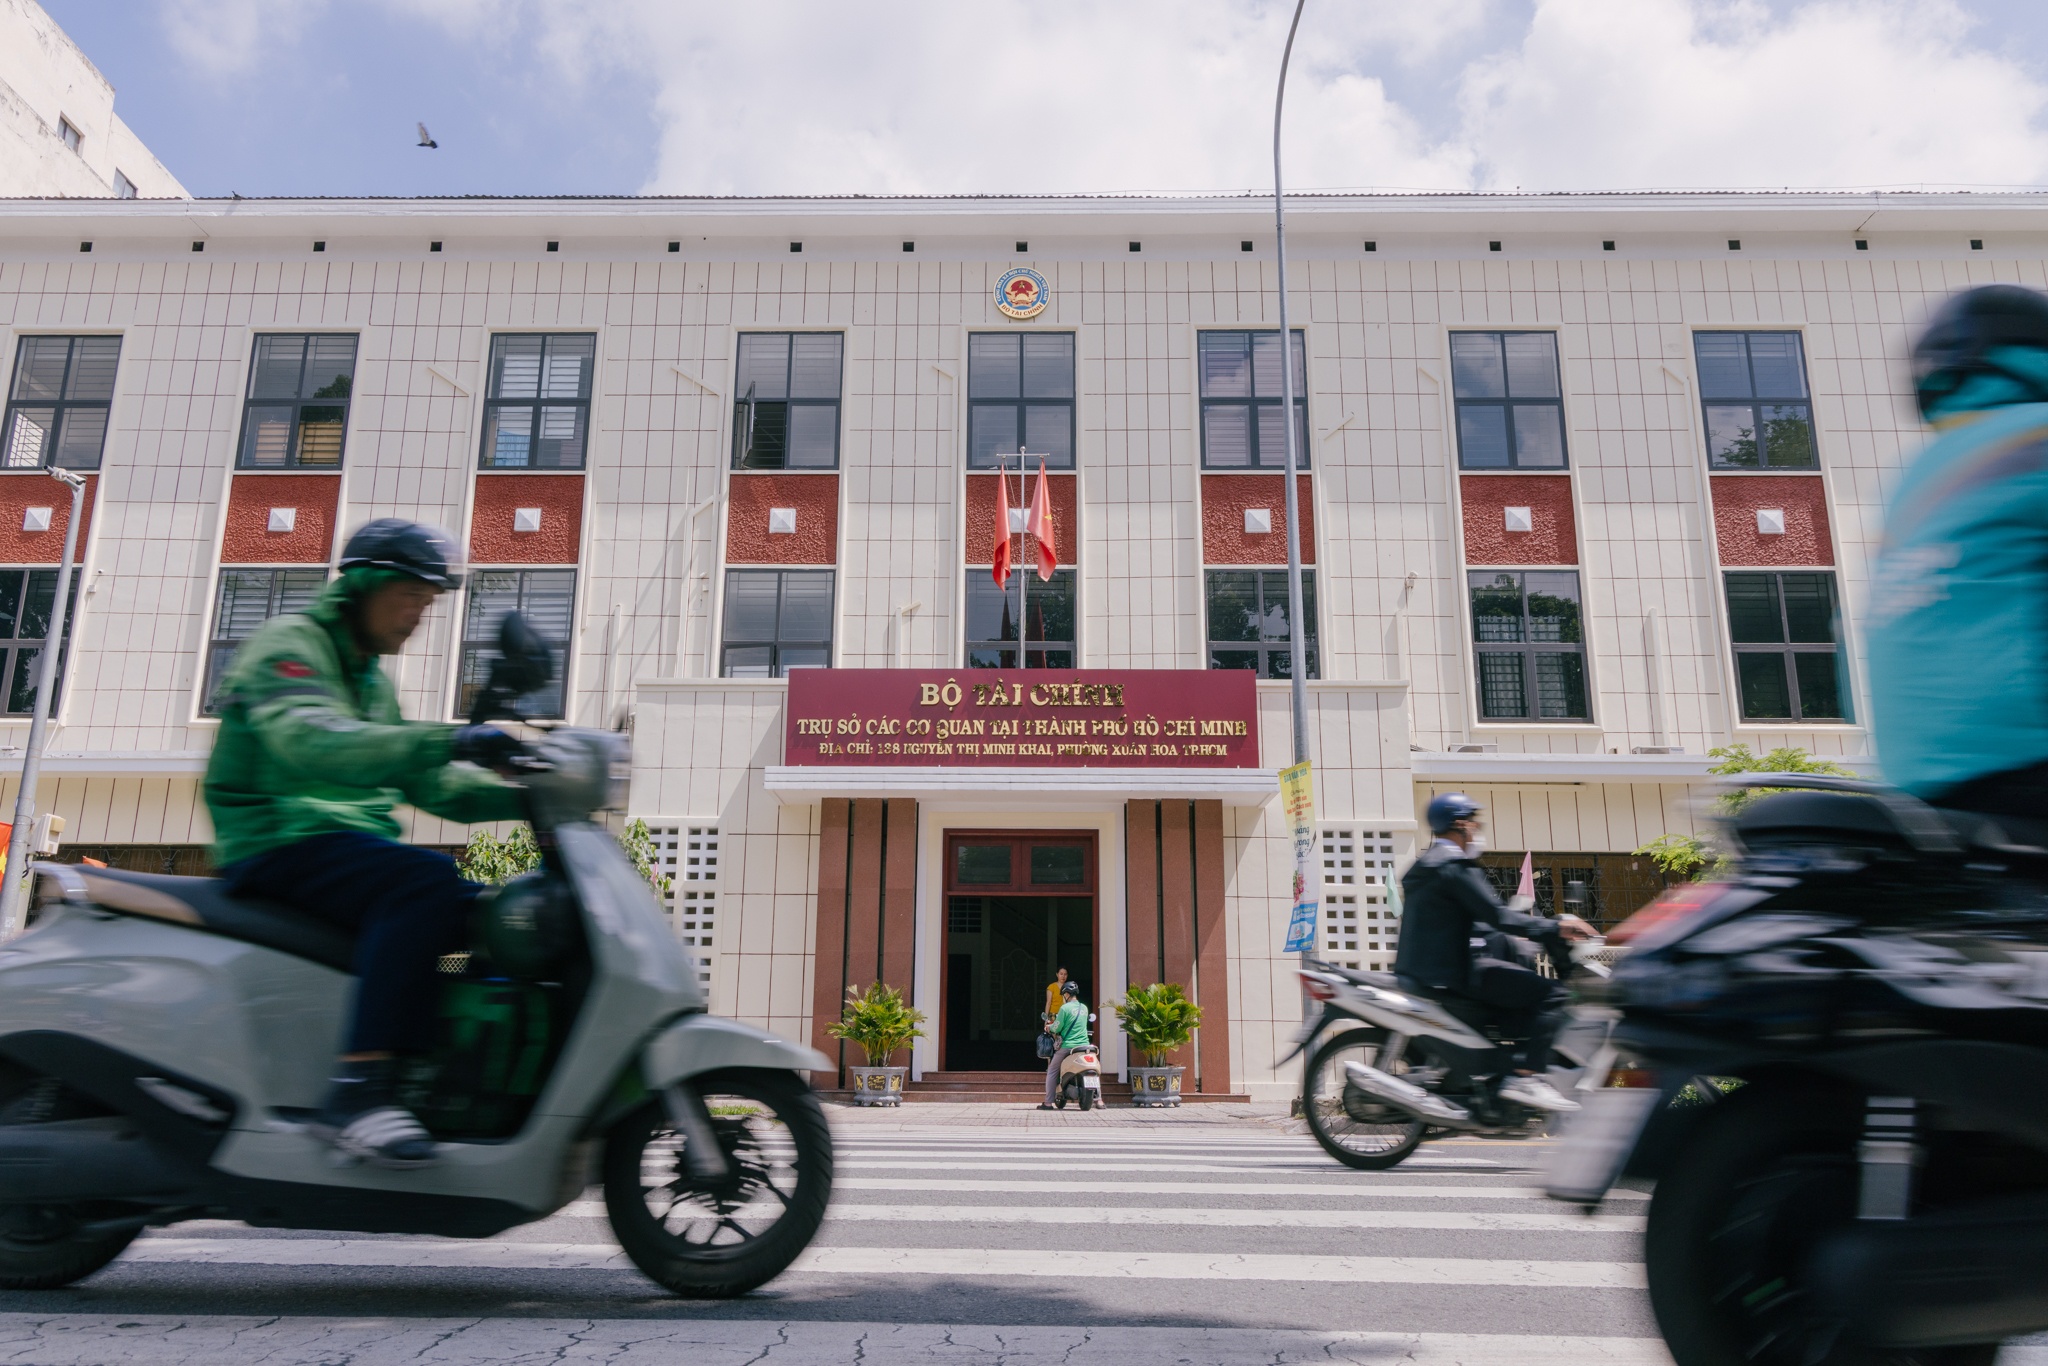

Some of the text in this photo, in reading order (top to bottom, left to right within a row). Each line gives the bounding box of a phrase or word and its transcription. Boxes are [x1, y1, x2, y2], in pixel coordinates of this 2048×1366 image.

[920, 678, 1125, 711] BỘ TÀI CHÍNH
[797, 713, 1247, 739] TRỤ SỞ CÁC CƠ QUAN TẠI THÀNH PHỐ HỒ CHÍ MINH
[819, 743, 843, 757] ĐỊA
[847, 739, 873, 754] CHỈ:
[877, 743, 900, 754] 138
[903, 740, 953, 755] NGUYỄN
[957, 744, 979, 757] THỊ
[983, 744, 1016, 755] MINH
[1018, 744, 1054, 757] KHAI,
[1112, 742, 1147, 756] XUÂN
[1183, 744, 1228, 756] TP.HCM
